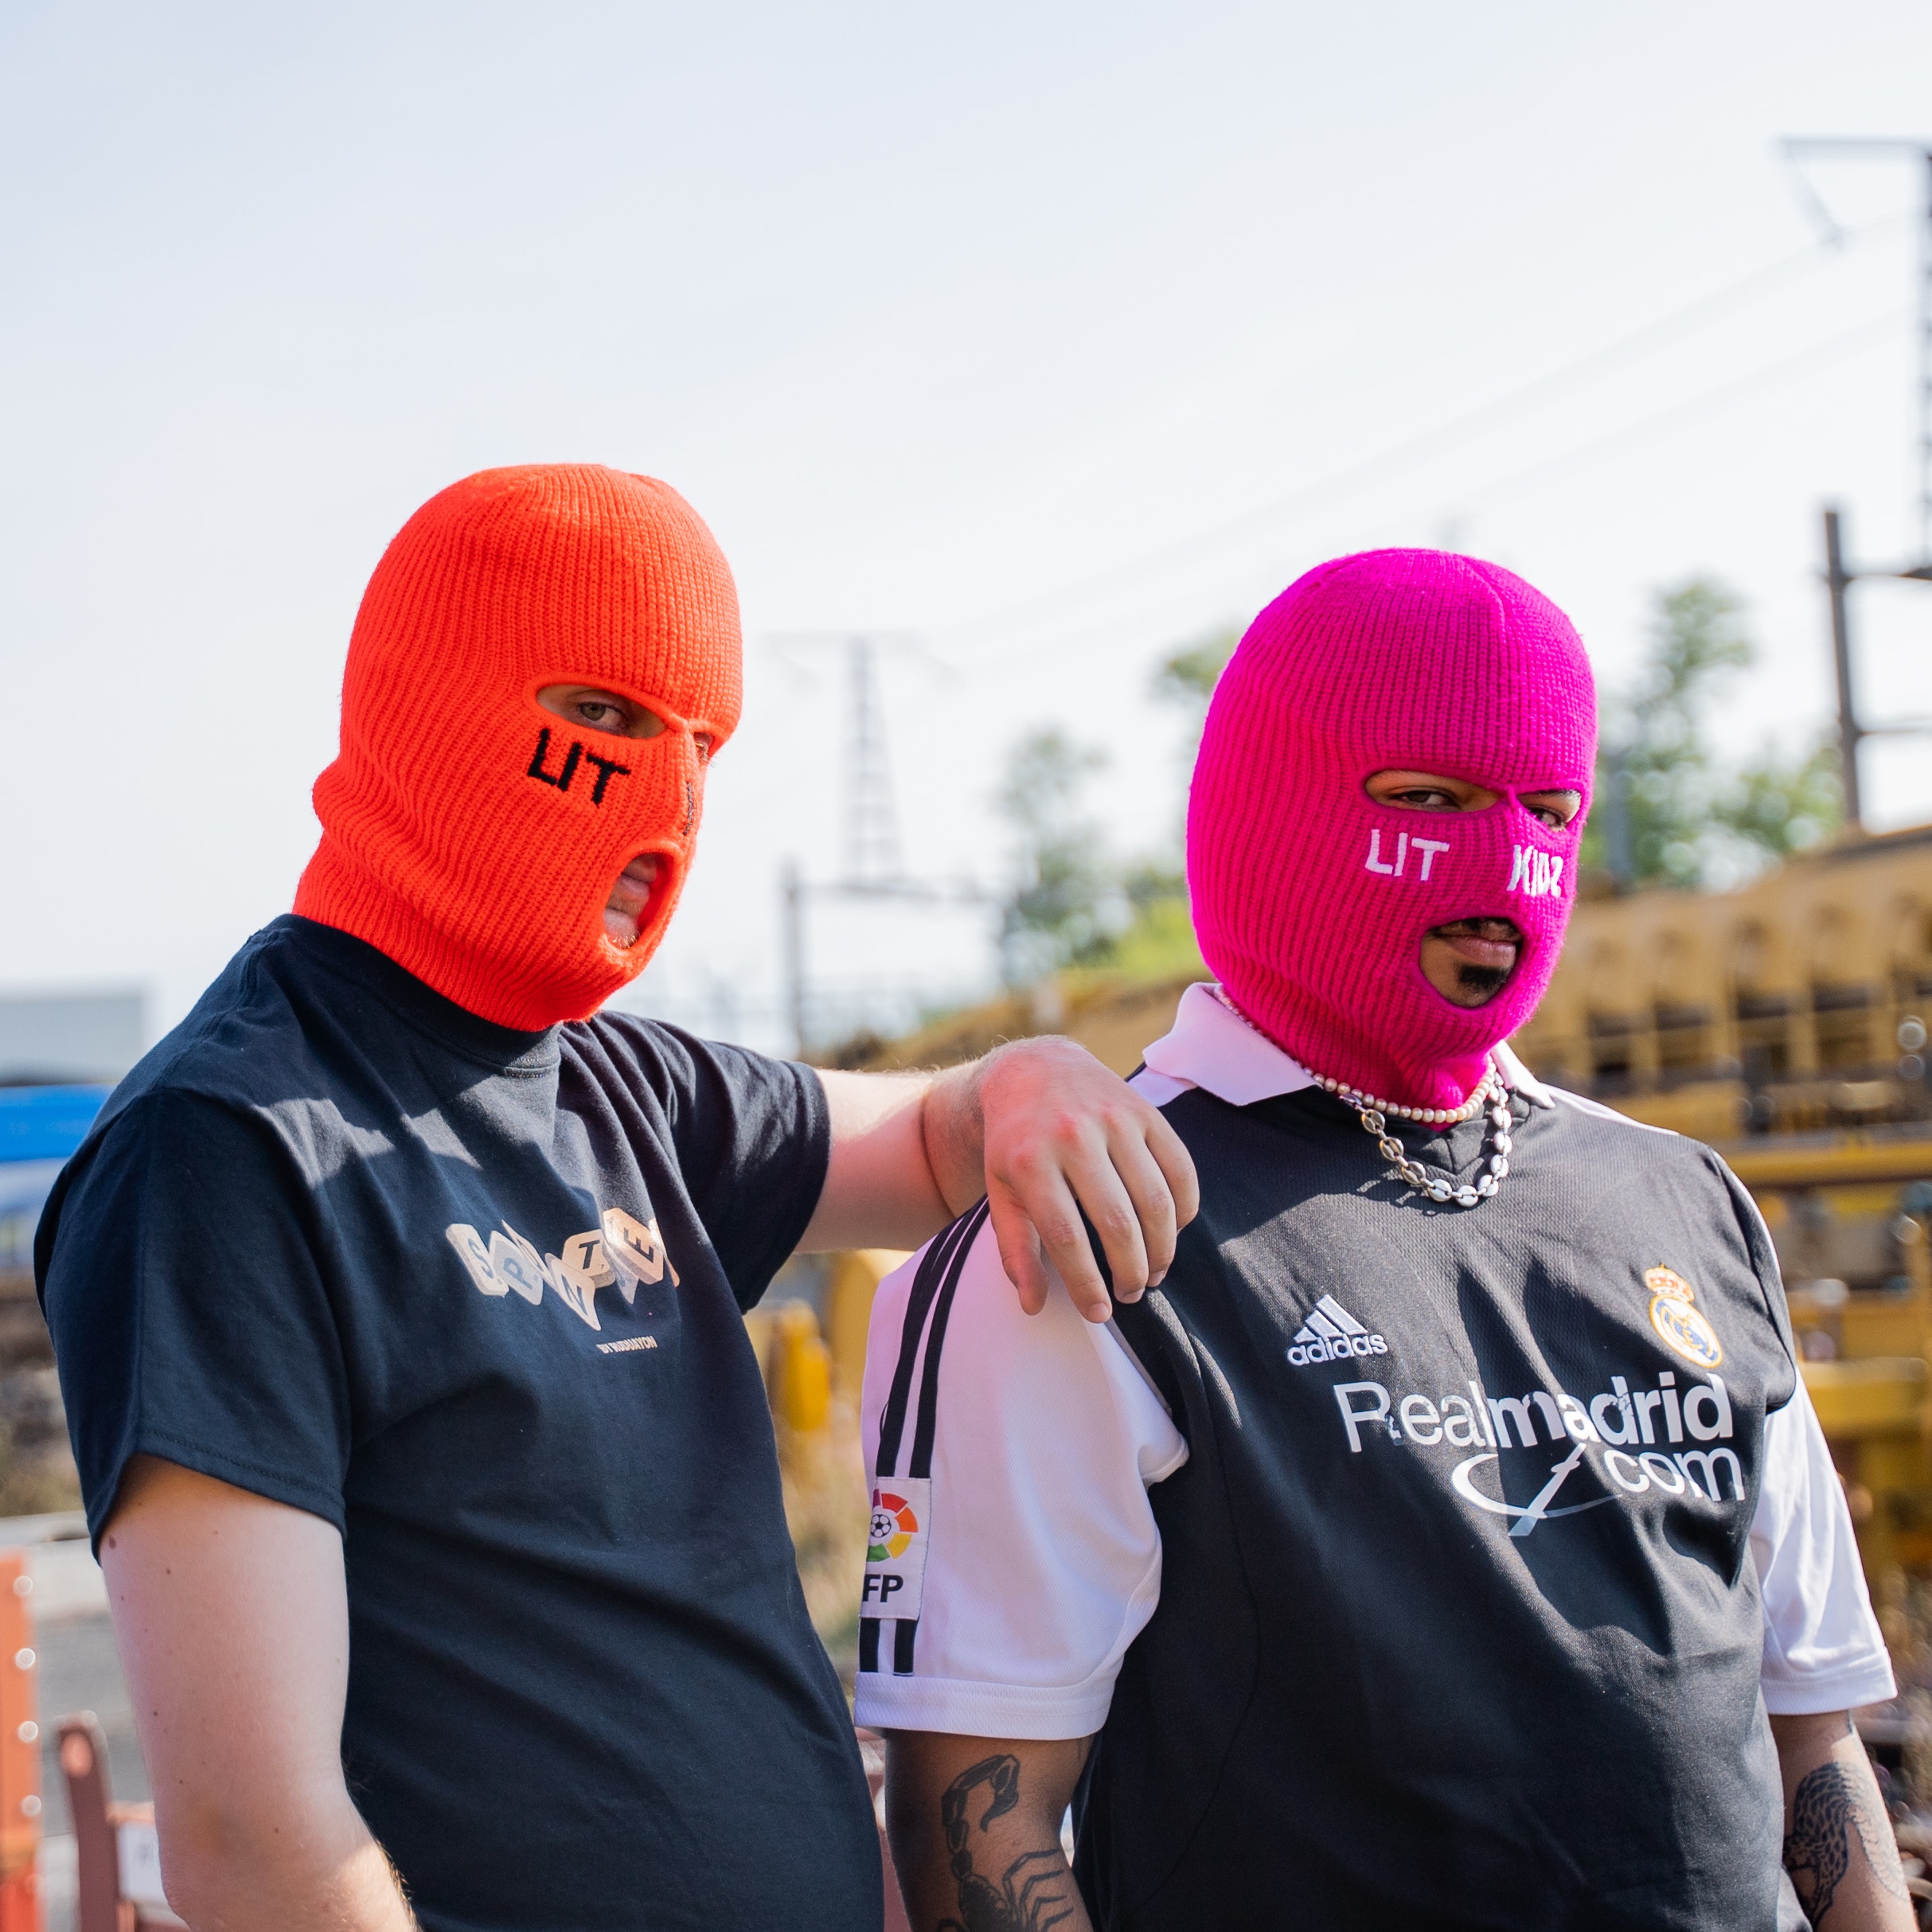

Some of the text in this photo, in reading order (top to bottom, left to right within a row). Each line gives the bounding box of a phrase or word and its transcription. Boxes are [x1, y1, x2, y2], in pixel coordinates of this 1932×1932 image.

[527, 728, 631, 806] LIT
[1364, 829, 1563, 897] LIT KIDZ
[1287, 1332, 1388, 1366] adidas
[1333, 1372, 1733, 1453] Realmadrid
